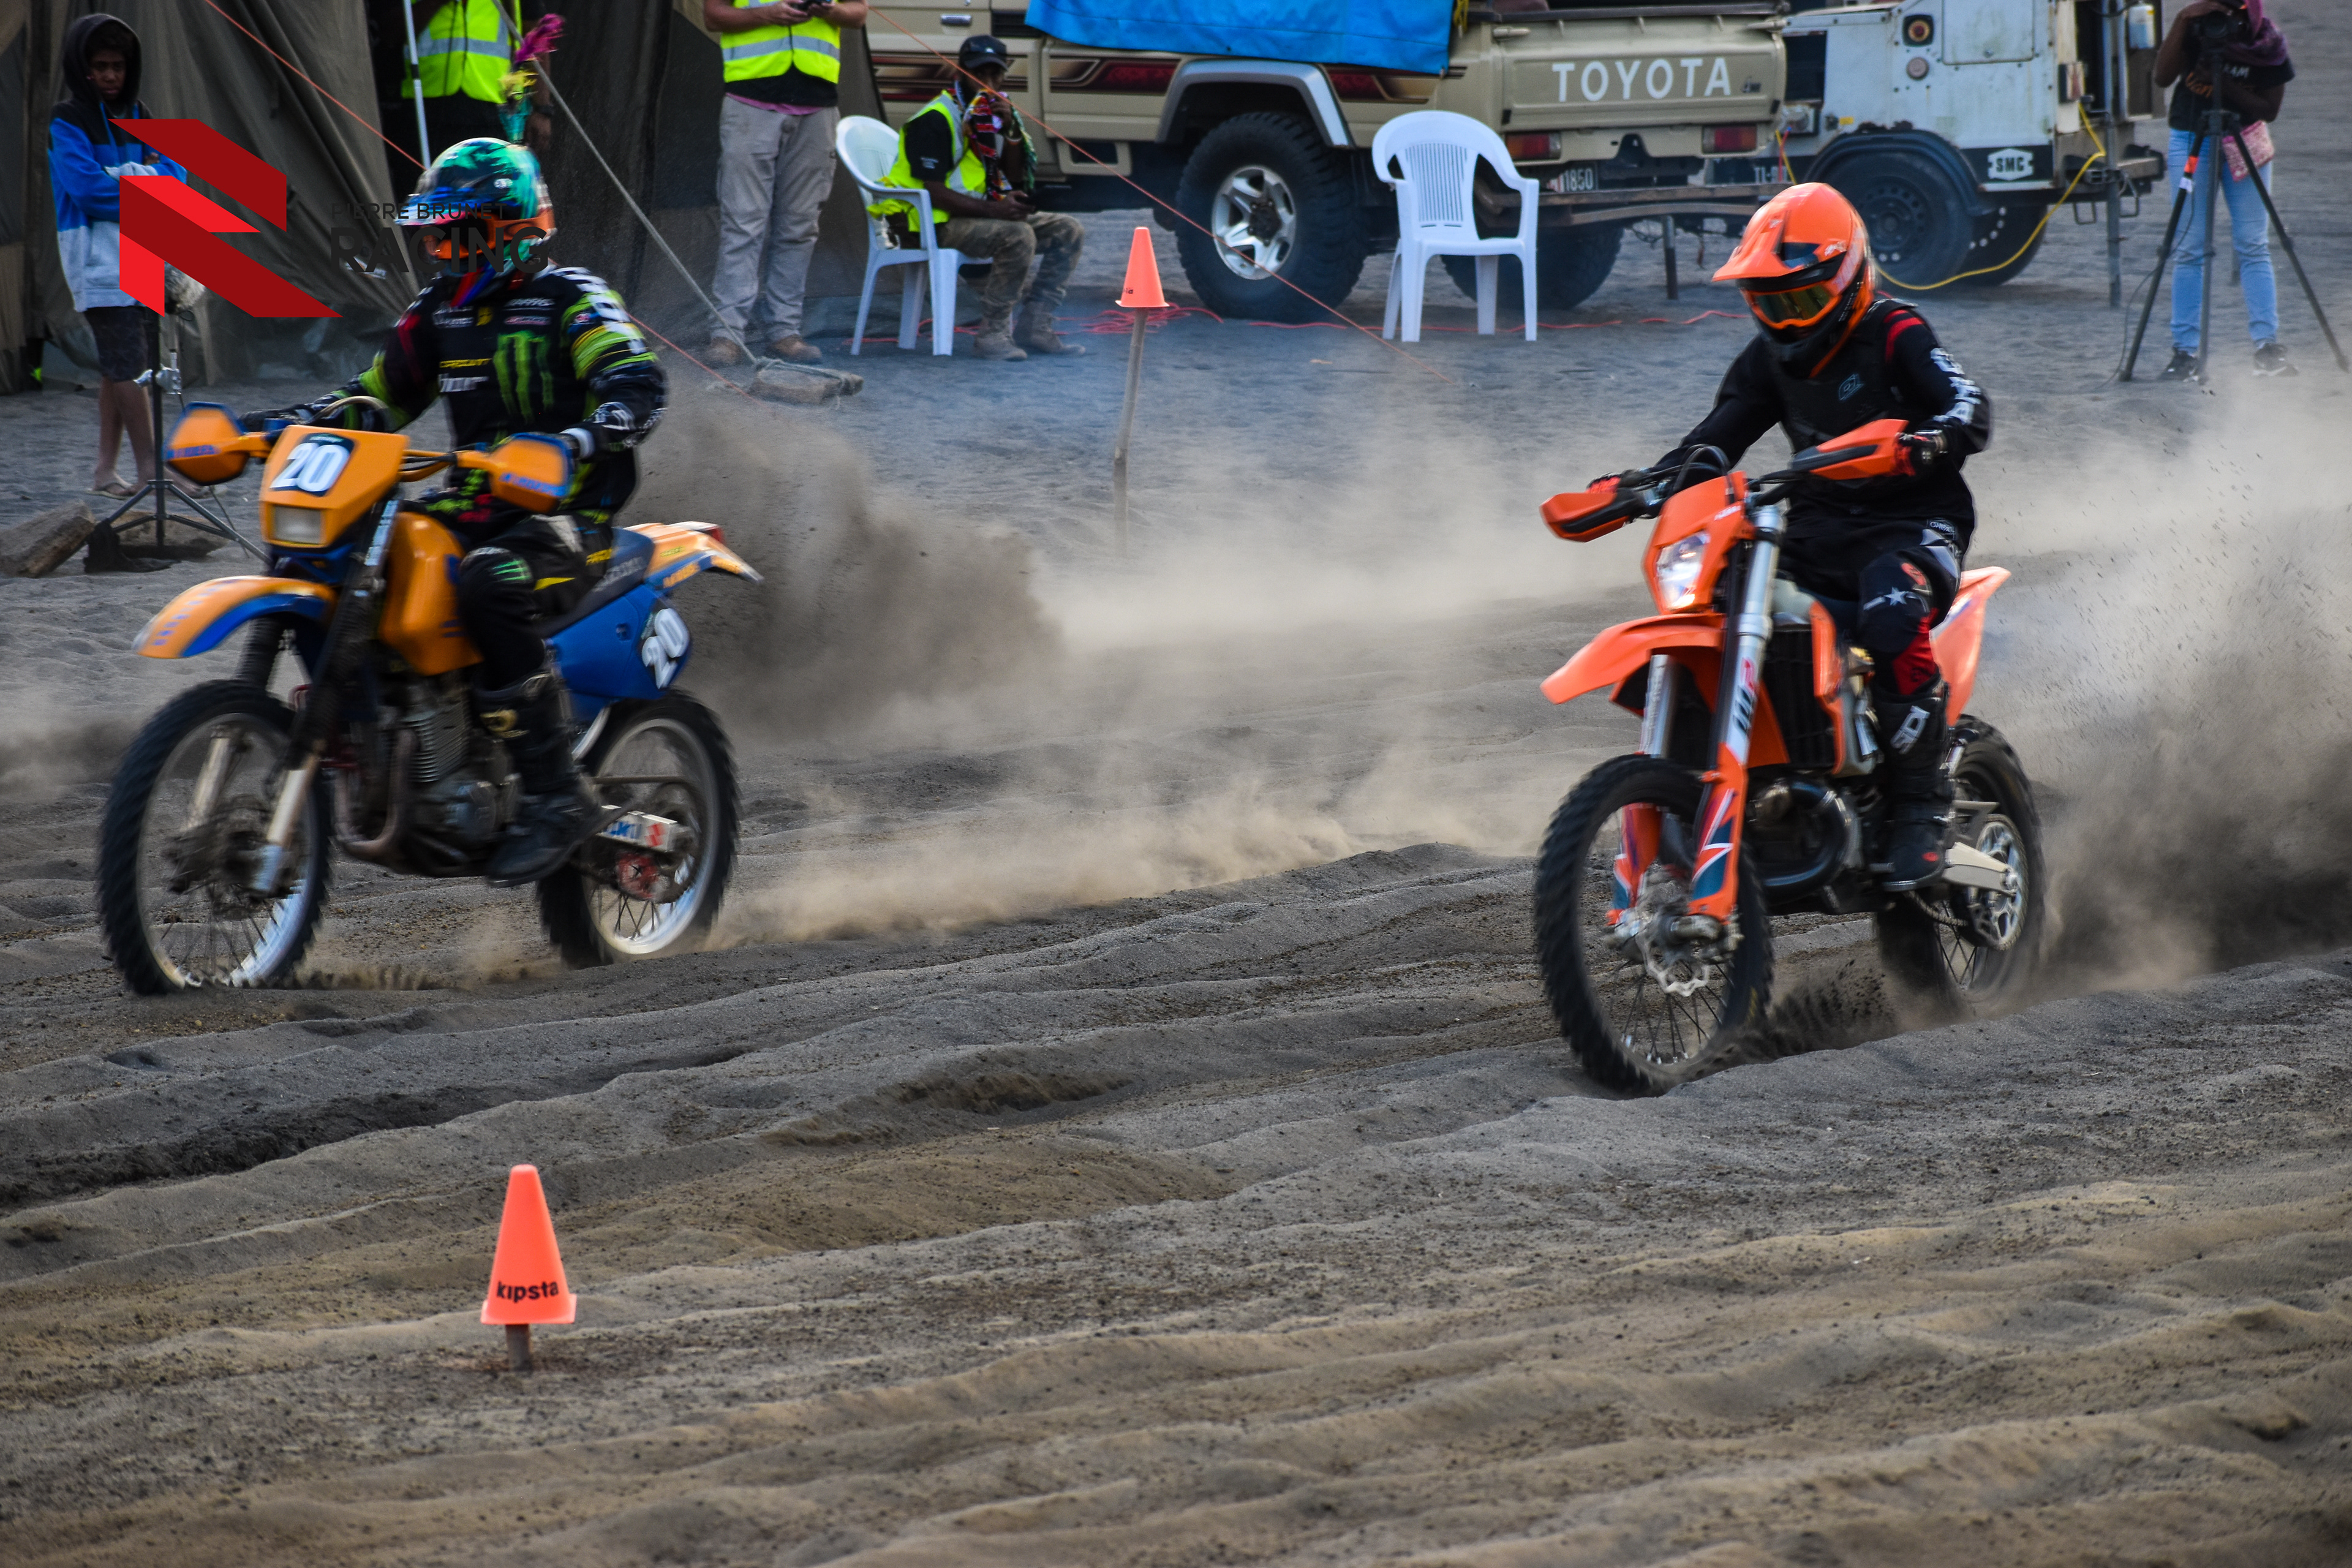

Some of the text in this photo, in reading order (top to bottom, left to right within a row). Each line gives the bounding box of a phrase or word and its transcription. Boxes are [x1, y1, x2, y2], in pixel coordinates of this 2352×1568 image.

[1551, 56, 1732, 103] TOYOTA
[1995, 156, 2025, 173] SMC
[269, 442, 352, 492] 20
[641, 608, 690, 690] 20
[496, 1280, 560, 1303] kipsta
